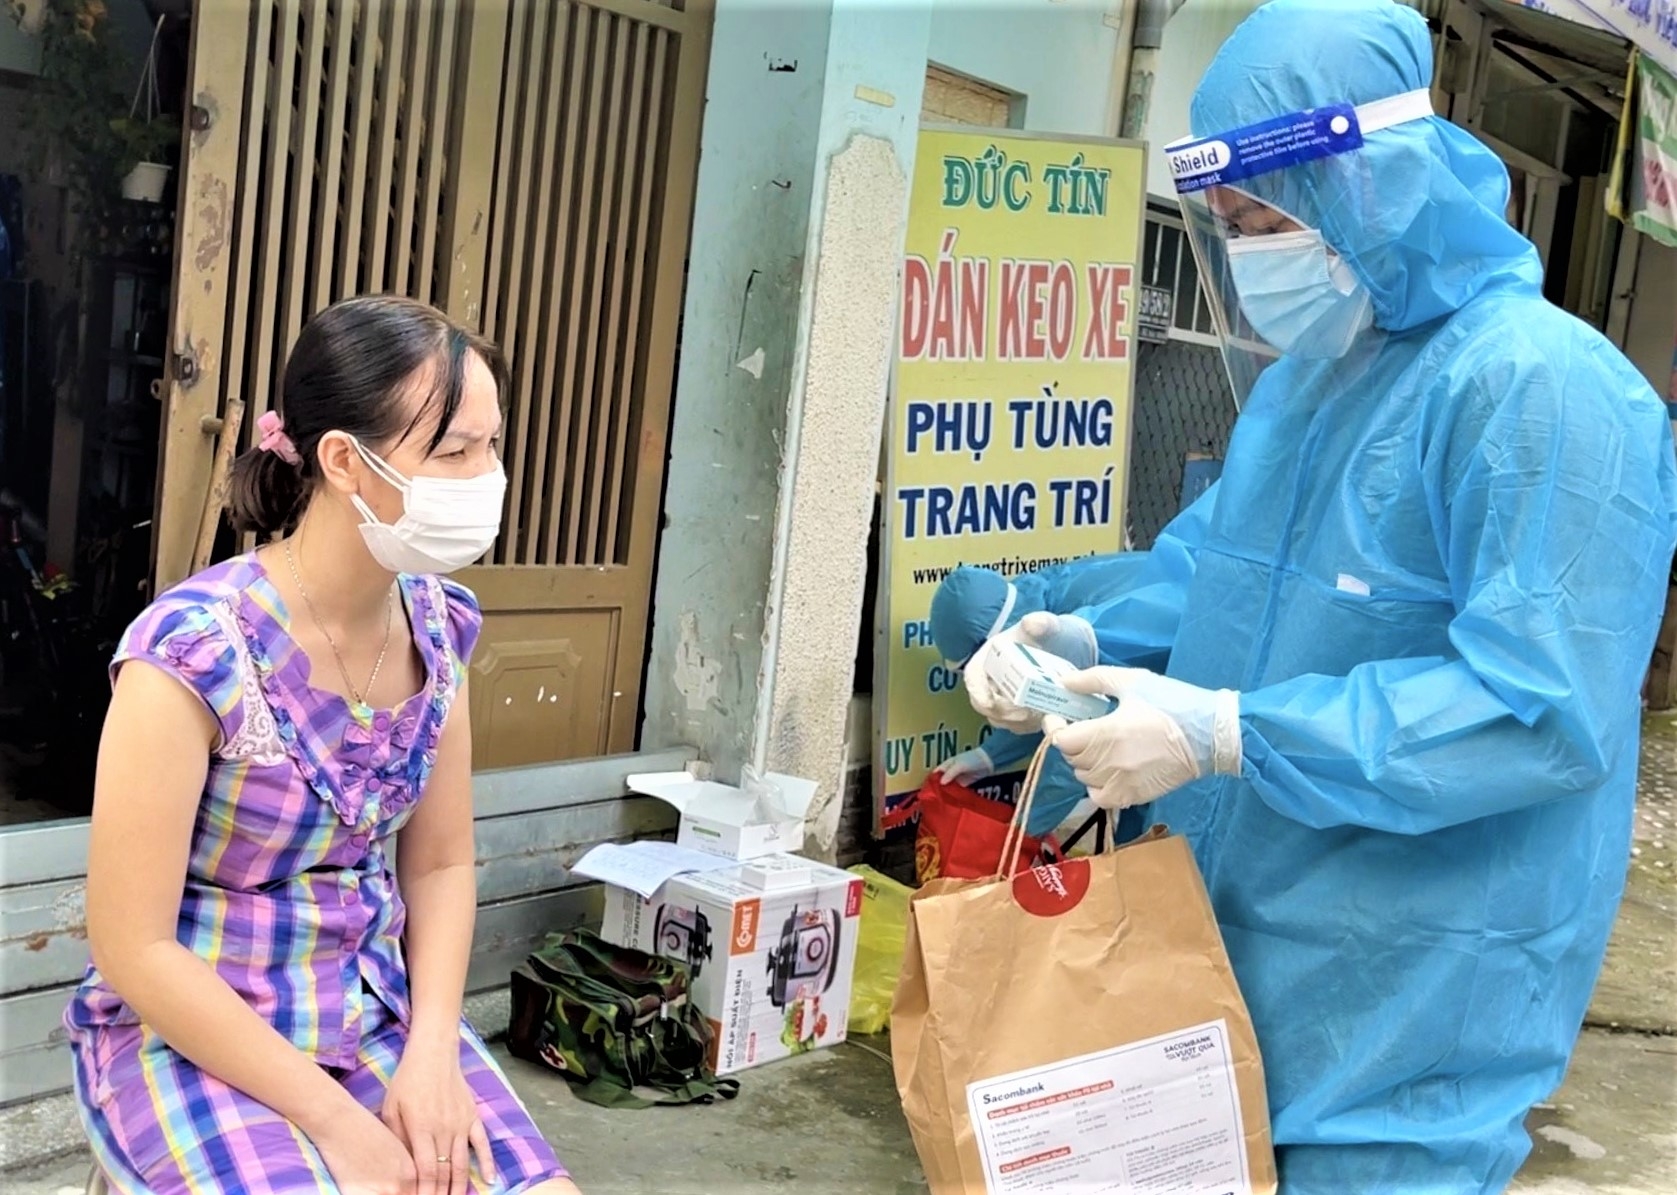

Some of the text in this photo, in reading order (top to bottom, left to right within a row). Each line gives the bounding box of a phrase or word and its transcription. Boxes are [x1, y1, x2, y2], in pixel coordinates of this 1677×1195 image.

[942, 144, 1112, 216] ĐỨC TÍN
[1173, 146, 1219, 174] Shield
[1200, 171, 1222, 186] mask
[901, 229, 1133, 360] DÁN KEO XE
[907, 381, 1113, 461] PHỤ TÙNG
[898, 466, 1115, 538] TRANG TRÍ
[886, 734, 915, 776] UY
[922, 722, 957, 768] TÍN
[1163, 1035, 1212, 1054] SACOMBANK
[983, 1082, 1045, 1105] Sacombank
